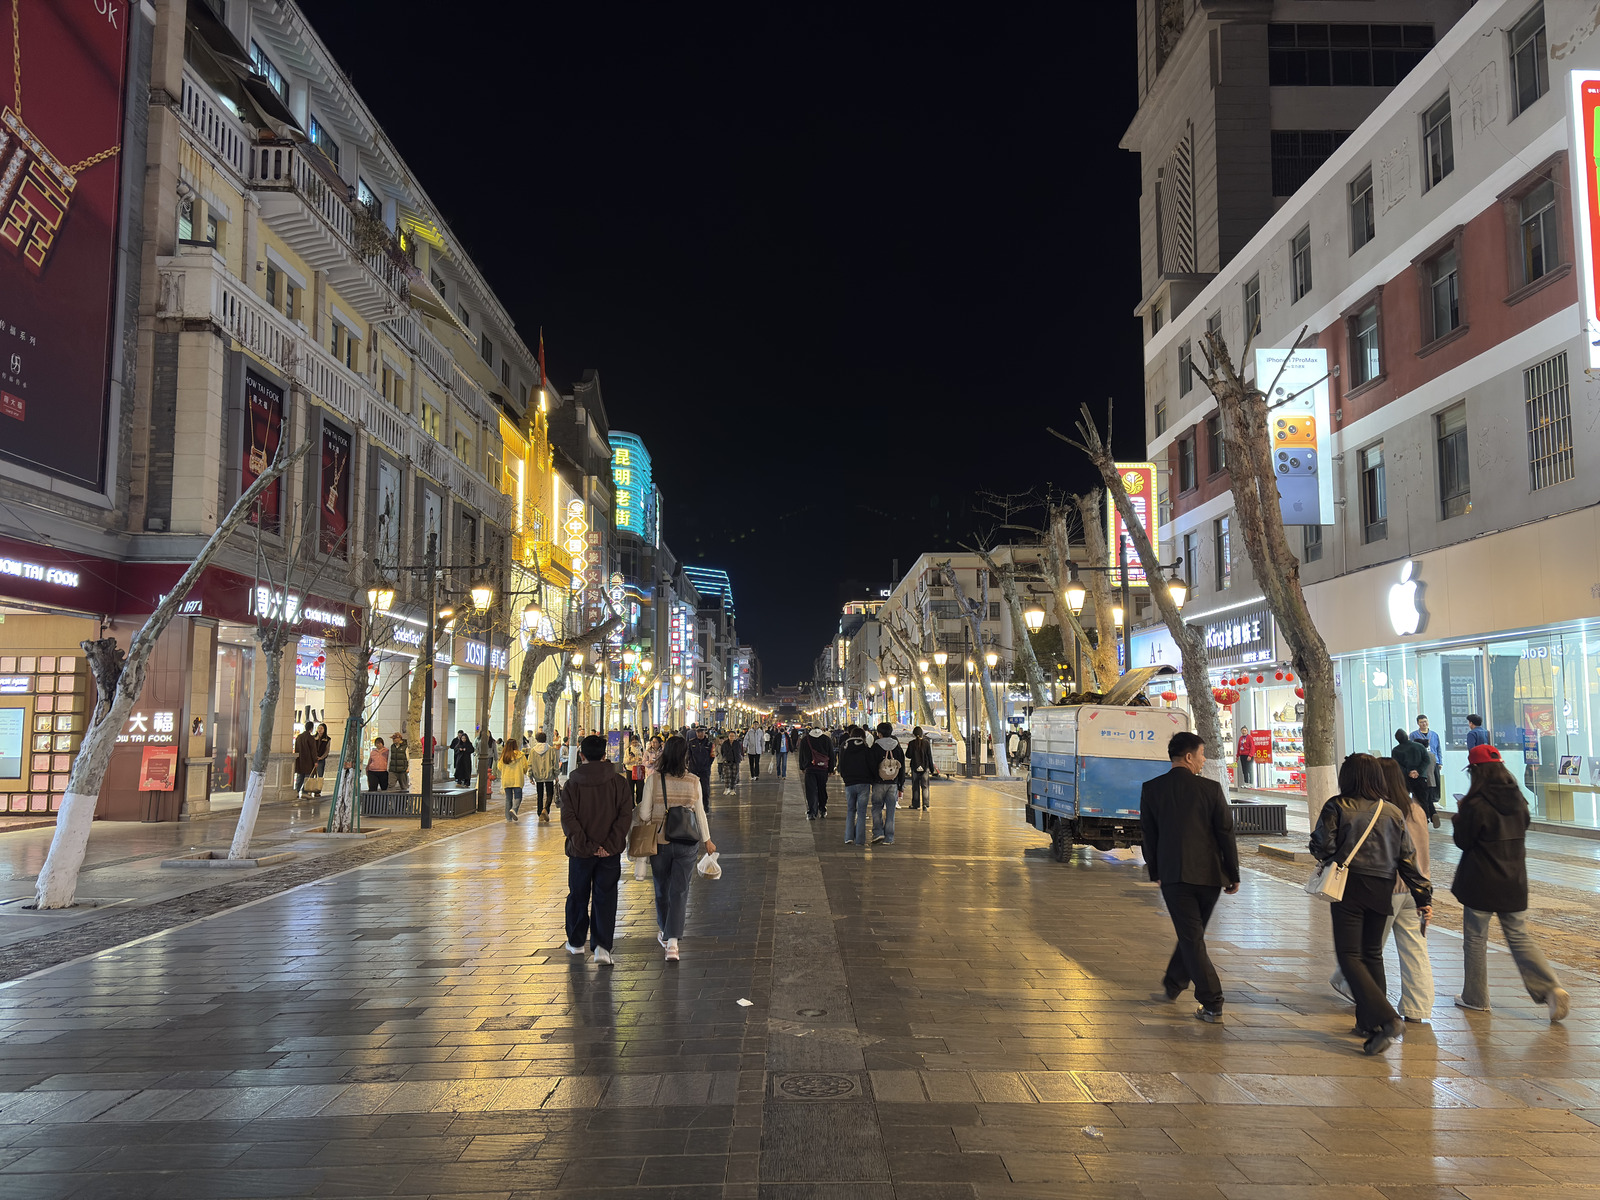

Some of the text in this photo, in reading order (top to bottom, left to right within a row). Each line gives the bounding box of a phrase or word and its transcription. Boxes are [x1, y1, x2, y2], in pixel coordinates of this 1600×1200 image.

[615, 447, 631, 526] 昆明老街
[23, 562, 45, 581] TAI
[46, 566, 80, 588] FOOK
[130, 734, 146, 743] TAI
[147, 734, 173, 743] FOOK
[1129, 729, 1156, 741] 012
